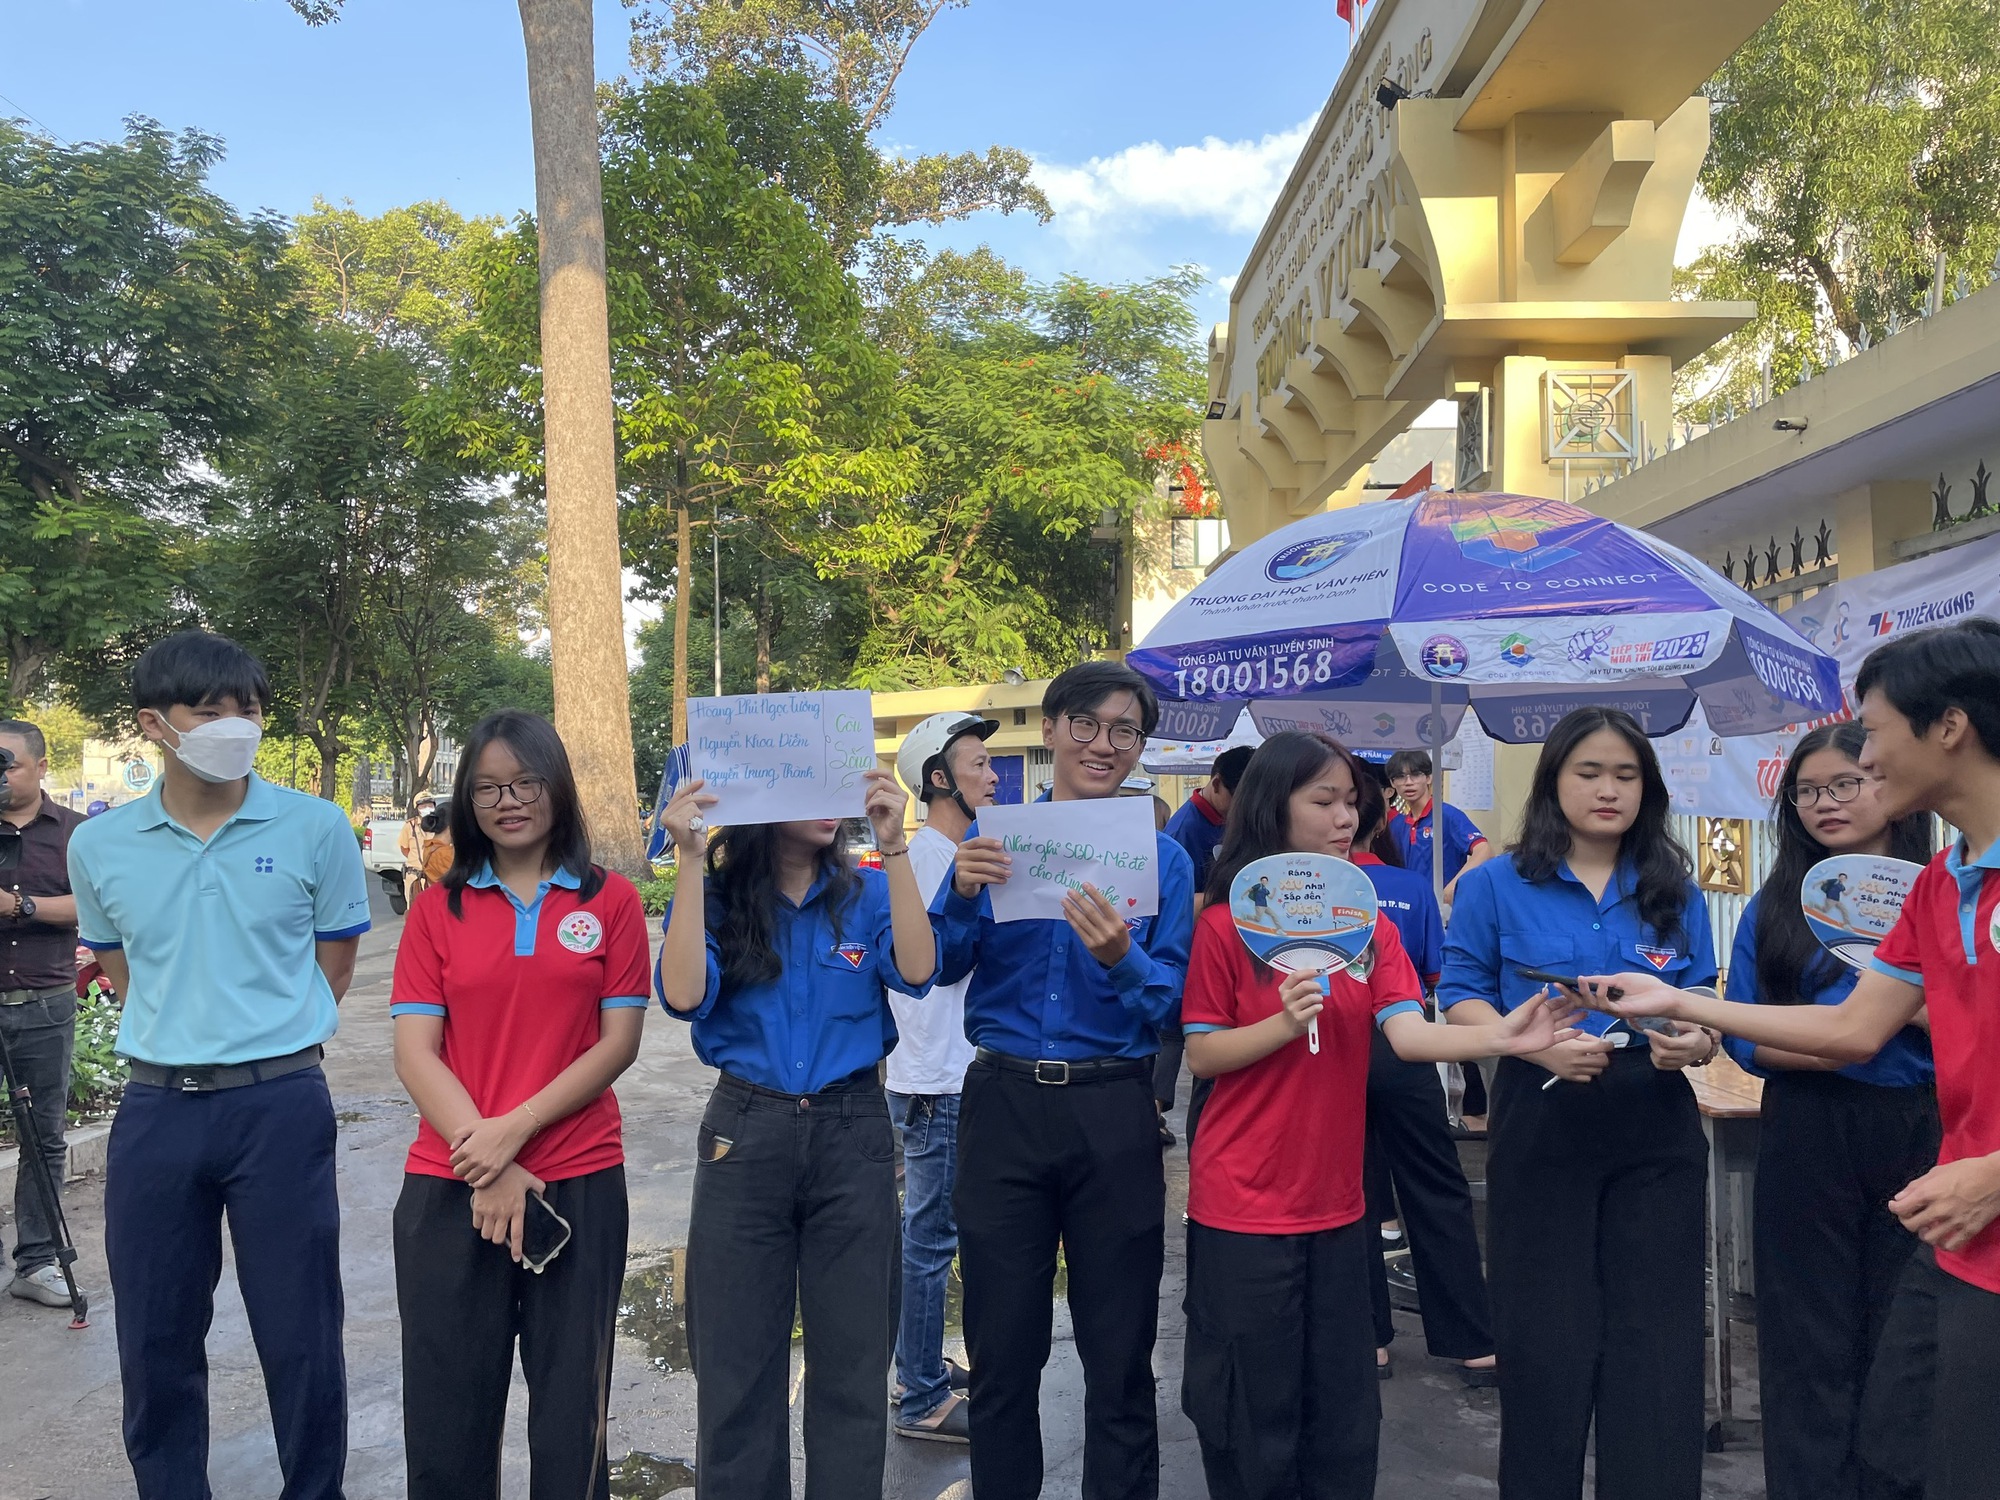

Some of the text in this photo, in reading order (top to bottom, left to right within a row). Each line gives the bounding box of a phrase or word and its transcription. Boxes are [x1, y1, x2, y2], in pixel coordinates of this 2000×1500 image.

[1190, 594, 1248, 608] TRƯỜNG
[1249, 588, 1279, 603] ĐẠI
[1279, 583, 1314, 599] HỌC
[1351, 567, 1390, 585] HIẾN
[1327, 587, 1358, 601] Danh
[1422, 572, 1660, 594] CODE TO CONNECT
[1177, 636, 1334, 668] TỔNG ĐÀI TƯ VẤN TUYỂN SINH
[1653, 634, 1707, 660] 2023
[1173, 650, 1333, 697] 18001568
[1488, 672, 1508, 680] CODE
[1523, 670, 1557, 678] CONNECT
[1750, 651, 1822, 704] 18001568
[745, 733, 775, 749] Khoa
[741, 762, 780, 789] Trung
[1003, 834, 1032, 853] Nhớ
[1063, 842, 1095, 861] SBD
[1288, 869, 1313, 878] Ráng
[1871, 873, 1899, 885] Ráng
[1304, 890, 1322, 901] đến
